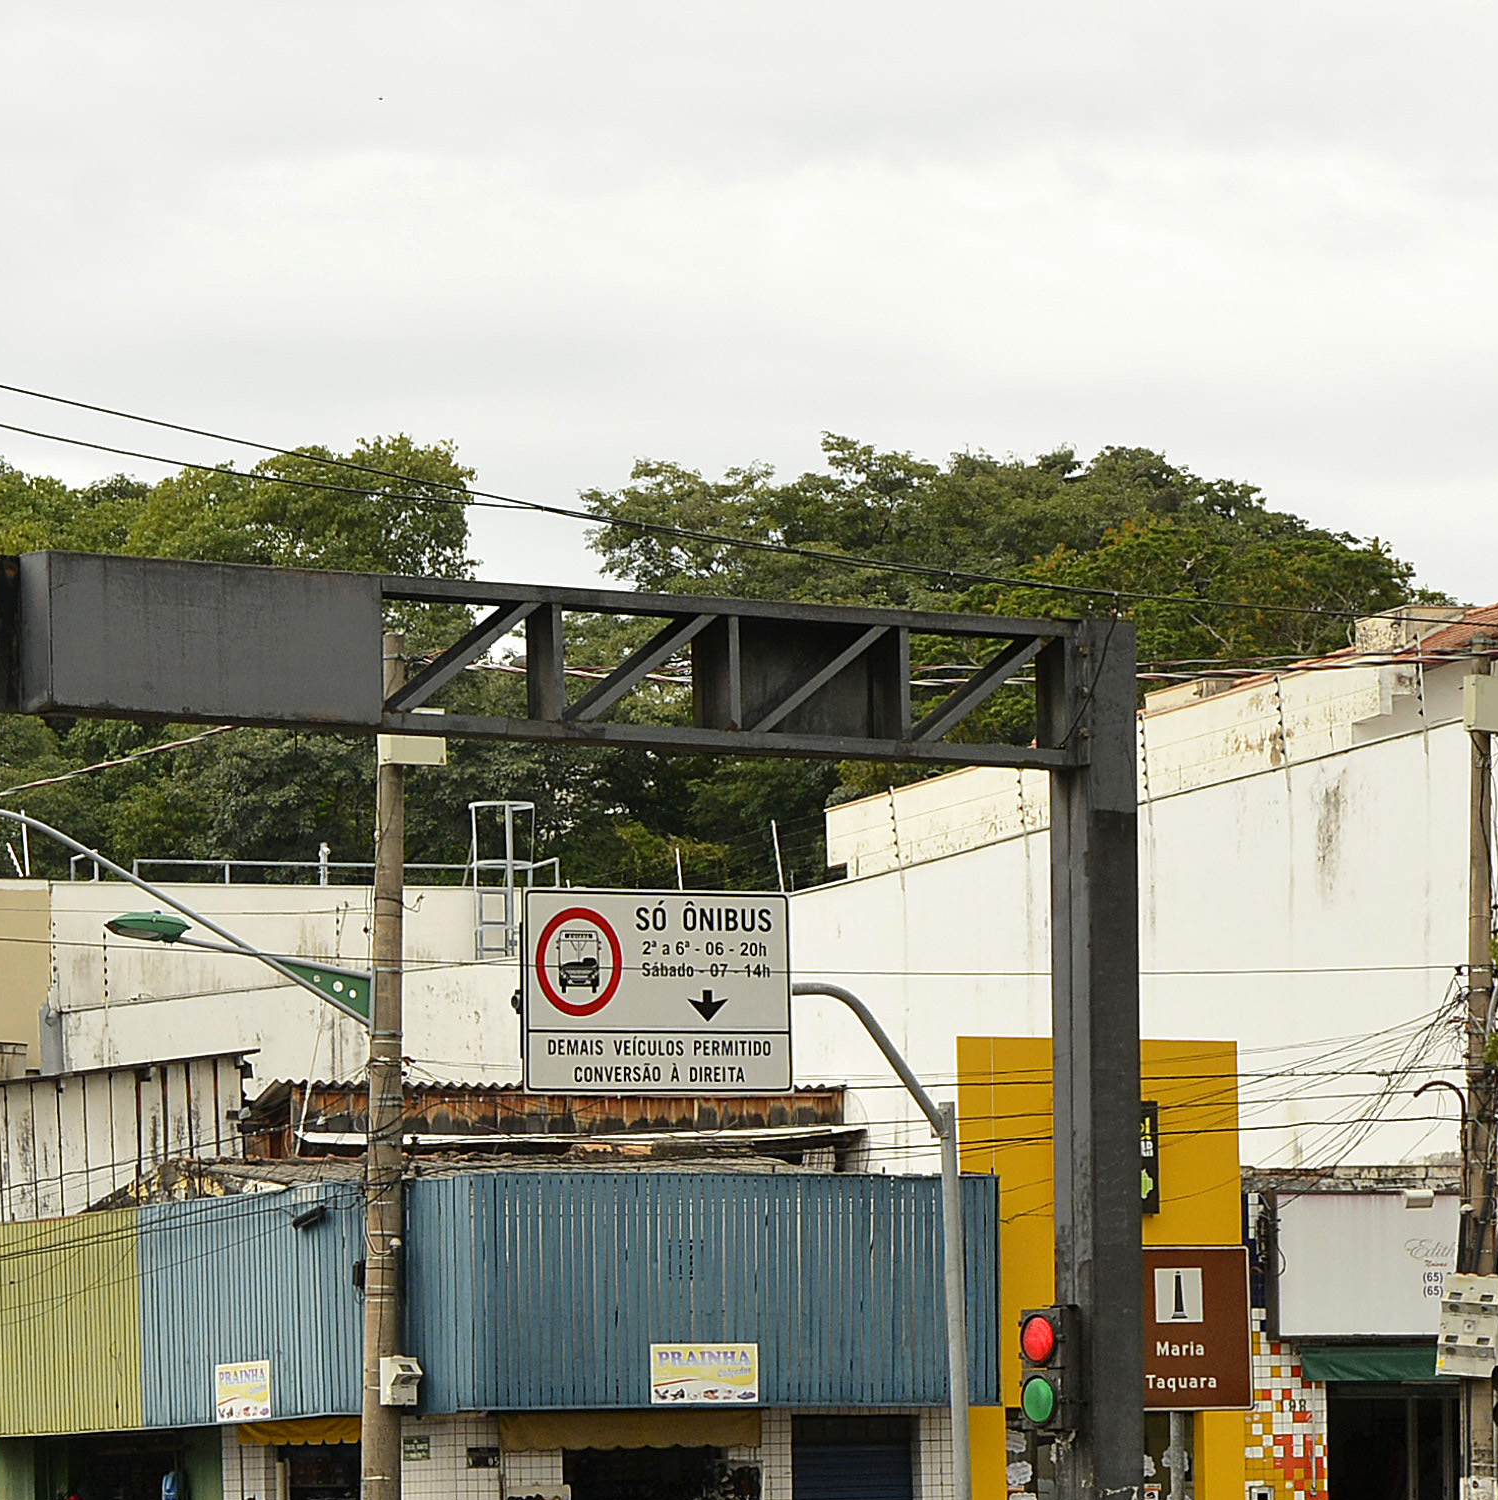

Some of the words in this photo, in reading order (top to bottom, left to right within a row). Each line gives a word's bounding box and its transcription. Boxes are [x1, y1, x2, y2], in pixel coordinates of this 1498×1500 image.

[635, 900, 666, 932] SÓ
[683, 901, 772, 933] ÔNIBUS
[662, 944, 670, 956] a
[705, 941, 724, 956] 06
[740, 942, 767, 957] 20h
[642, 962, 694, 978] Sábado
[710, 963, 728, 977] 07
[744, 963, 771, 978] 14h
[548, 1039, 604, 1056] DEMAIS
[613, 1036, 684, 1056] VEÍCULOS
[693, 1040, 771, 1057] PERMITIDO
[574, 1063, 661, 1083] CONVERSÃO
[671, 1063, 680, 1082] À
[689, 1066, 745, 1083] DIREITA
[1423, 1272, 1443, 1284] (65)
[1423, 1286, 1444, 1298] (65)
[1156, 1341, 1205, 1356] Maria
[657, 1350, 751, 1367] PRAINHA
[219, 1368, 265, 1386] PRAINHA
[1145, 1374, 1217, 1392] Taquara
